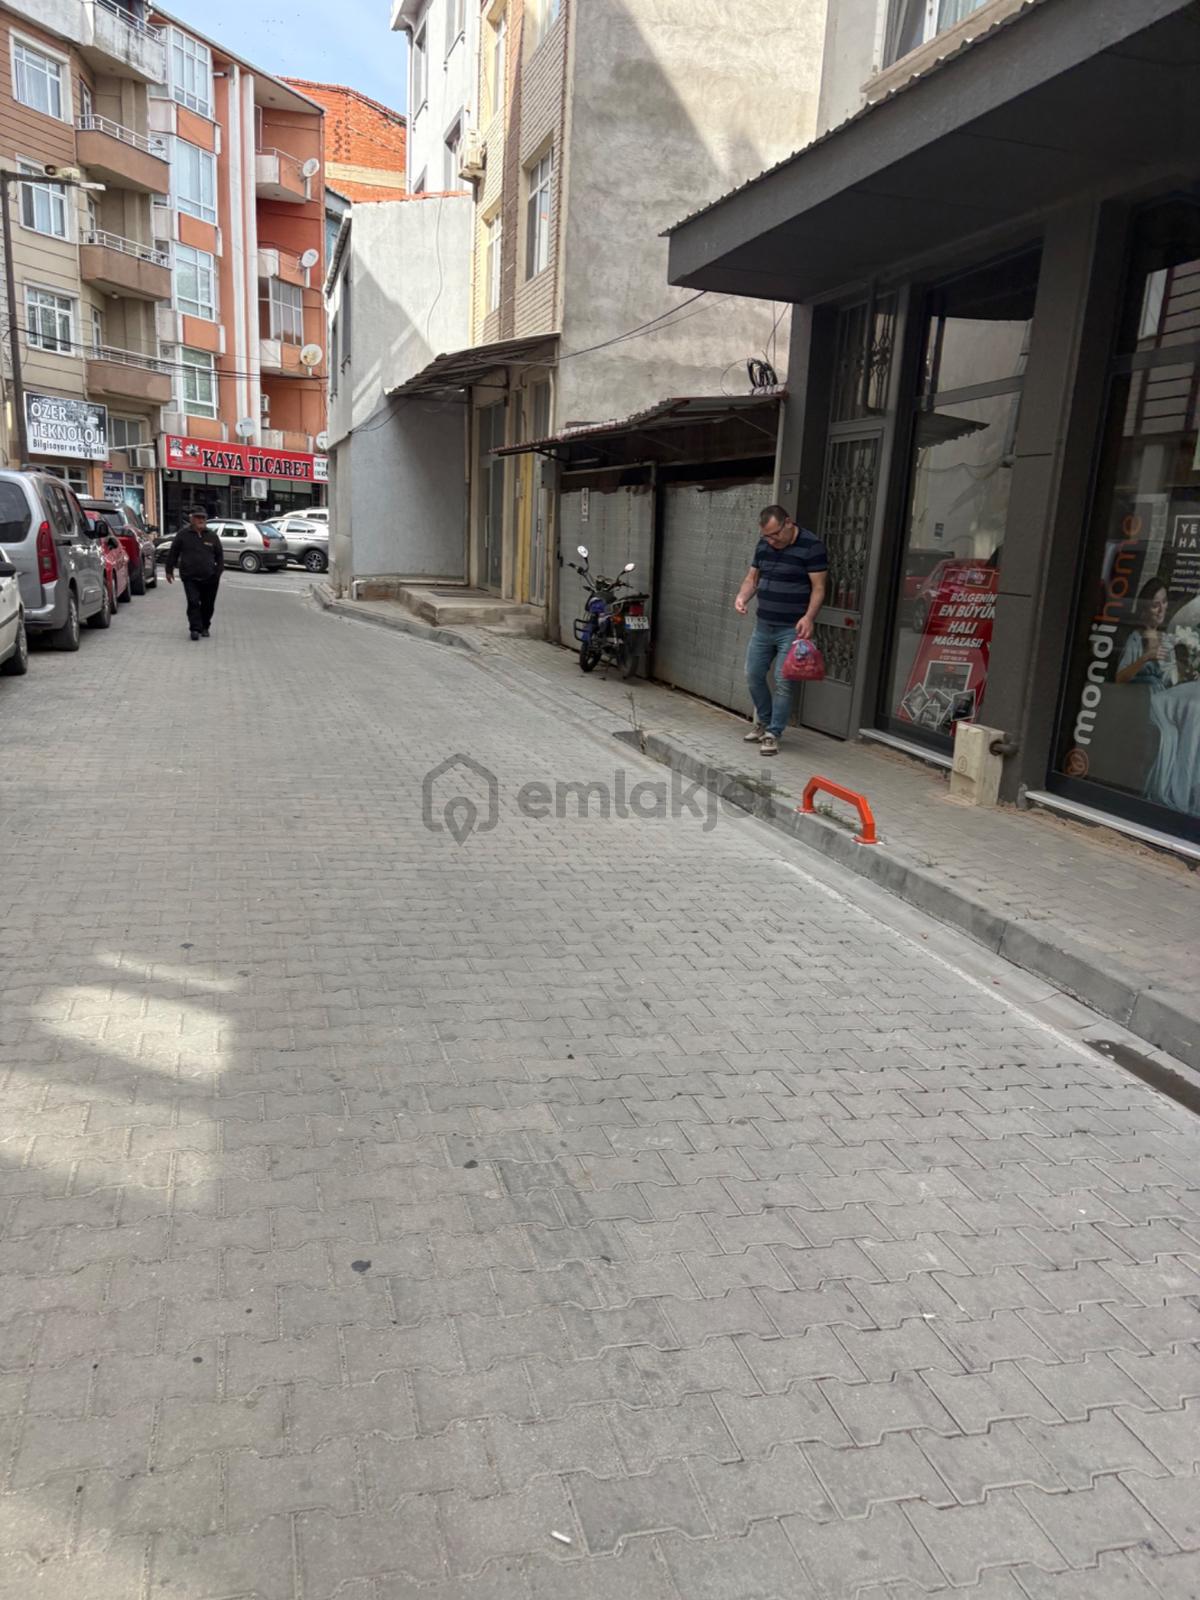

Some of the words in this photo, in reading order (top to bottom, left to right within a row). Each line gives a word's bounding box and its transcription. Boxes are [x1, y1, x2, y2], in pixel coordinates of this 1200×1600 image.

[31, 398, 66, 421] ÖZER
[33, 438, 67, 452] Bilgisayar
[202, 449, 245, 471] KAYA
[249, 450, 310, 477] TİCARET
[949, 592, 998, 604] BÖLGENİN
[938, 605, 955, 617] EN
[947, 621, 977, 634] HALI
